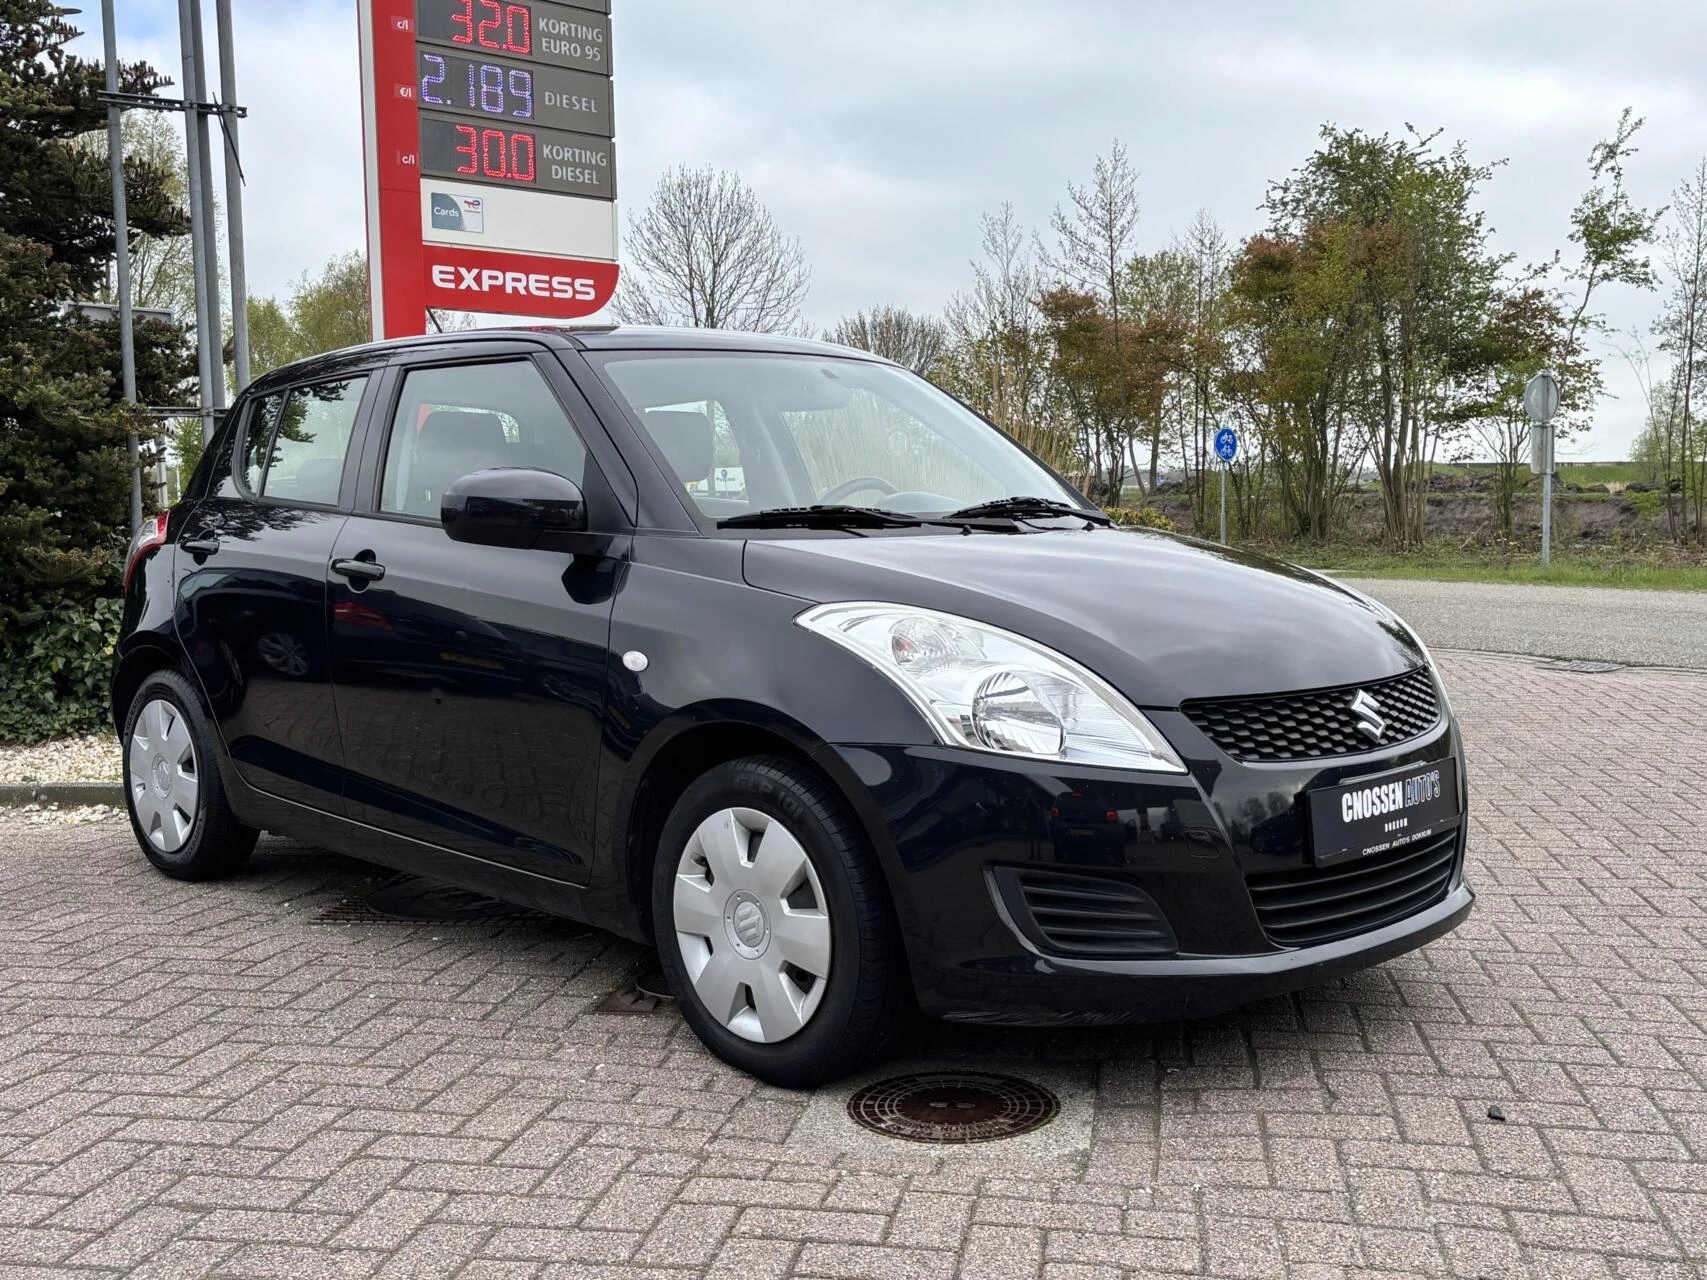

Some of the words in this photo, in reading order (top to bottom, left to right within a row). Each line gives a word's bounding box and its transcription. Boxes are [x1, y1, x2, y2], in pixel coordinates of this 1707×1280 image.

[539, 17, 603, 43] KORTING
[542, 38, 581, 58] EURO
[585, 47, 601, 62] 95
[422, 54, 532, 118] 2.189
[545, 91, 598, 113] DIESEL
[456, 125, 535, 181] 30.0
[543, 144, 607, 167] KORTING
[551, 165, 600, 185] DIESEL
[433, 206, 459, 218] Cards
[432, 264, 595, 301] EXPRESS
[1341, 781, 1403, 823] CNOSSEN
[1405, 770, 1440, 808] AUTO'S
[1362, 842, 1390, 856] CNOSSEN
